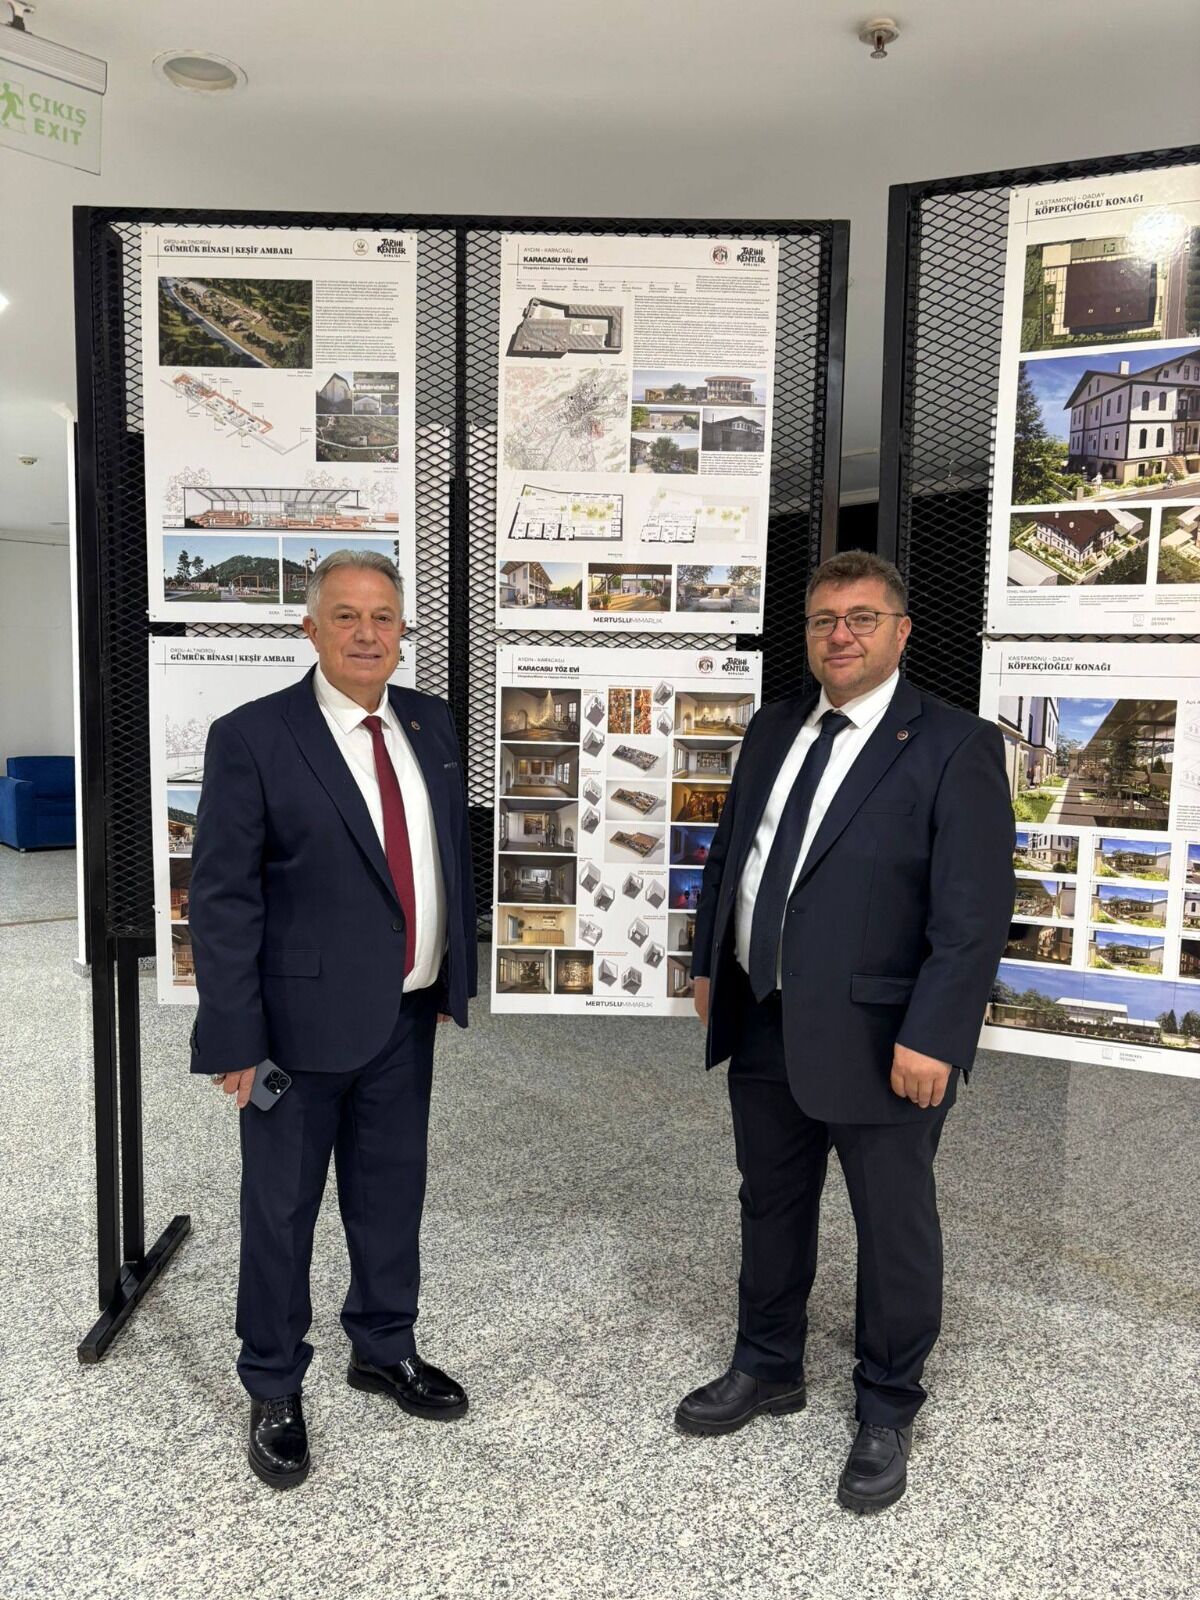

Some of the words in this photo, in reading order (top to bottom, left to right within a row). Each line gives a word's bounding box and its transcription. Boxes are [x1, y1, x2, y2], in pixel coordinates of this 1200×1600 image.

[29, 92, 87, 128] ÇIKIŞ
[34, 118, 82, 145] EXIT
[1035, 196, 1077, 206] KASTAMONU
[1082, 192, 1105, 200] DADAY
[1034, 199, 1103, 216] KÖPEKÇİOĞLU
[1105, 194, 1144, 207] KONAĞI
[164, 245, 200, 253] GÜMRÜK
[202, 246, 230, 254] BİNASI
[235, 246, 258, 255] KEŞİF
[260, 247, 293, 255] AMBARI
[377, 245, 406, 255] KENTLER
[562, 256, 576, 264] TÖZ
[577, 256, 589, 264] EVİ
[736, 254, 766, 263] KENTLER
[170, 653, 205, 661] GÜMRÜK
[239, 654, 261, 663] KEŞİF
[555, 665, 568, 673] TÖZ
[722, 664, 750, 673] KENTLER
[1008, 662, 1072, 671] KÖPEKÇİOĞLU
[1075, 662, 1111, 671] KONAĞI
